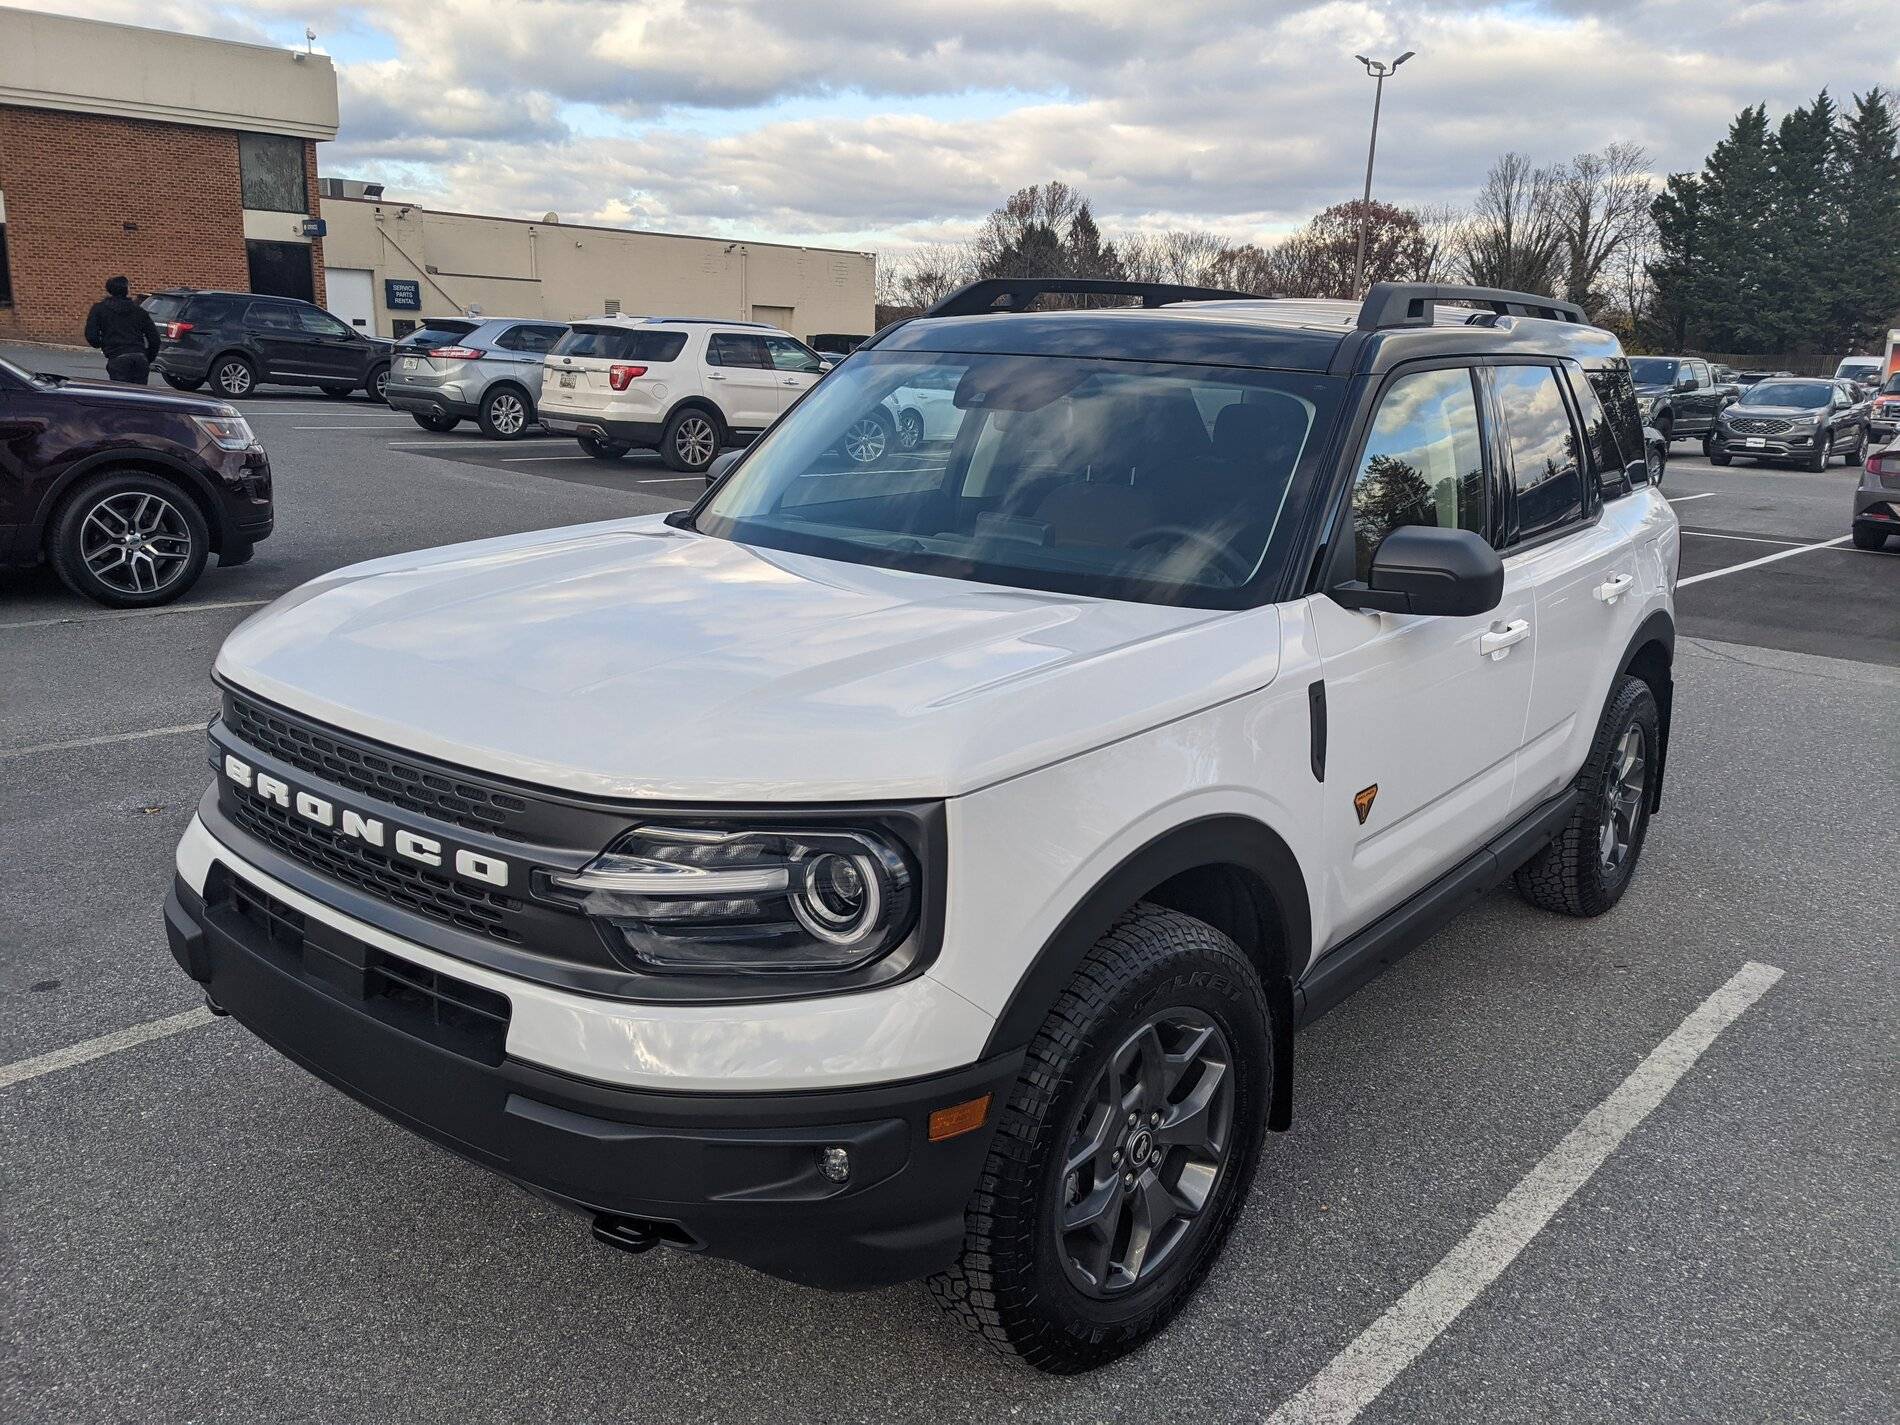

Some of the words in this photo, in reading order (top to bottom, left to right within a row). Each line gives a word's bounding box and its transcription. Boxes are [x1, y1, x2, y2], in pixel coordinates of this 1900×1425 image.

[392, 284, 416, 292] SERVICE
[394, 297, 416, 305] RENTAL
[224, 754, 509, 888] BRONCO
